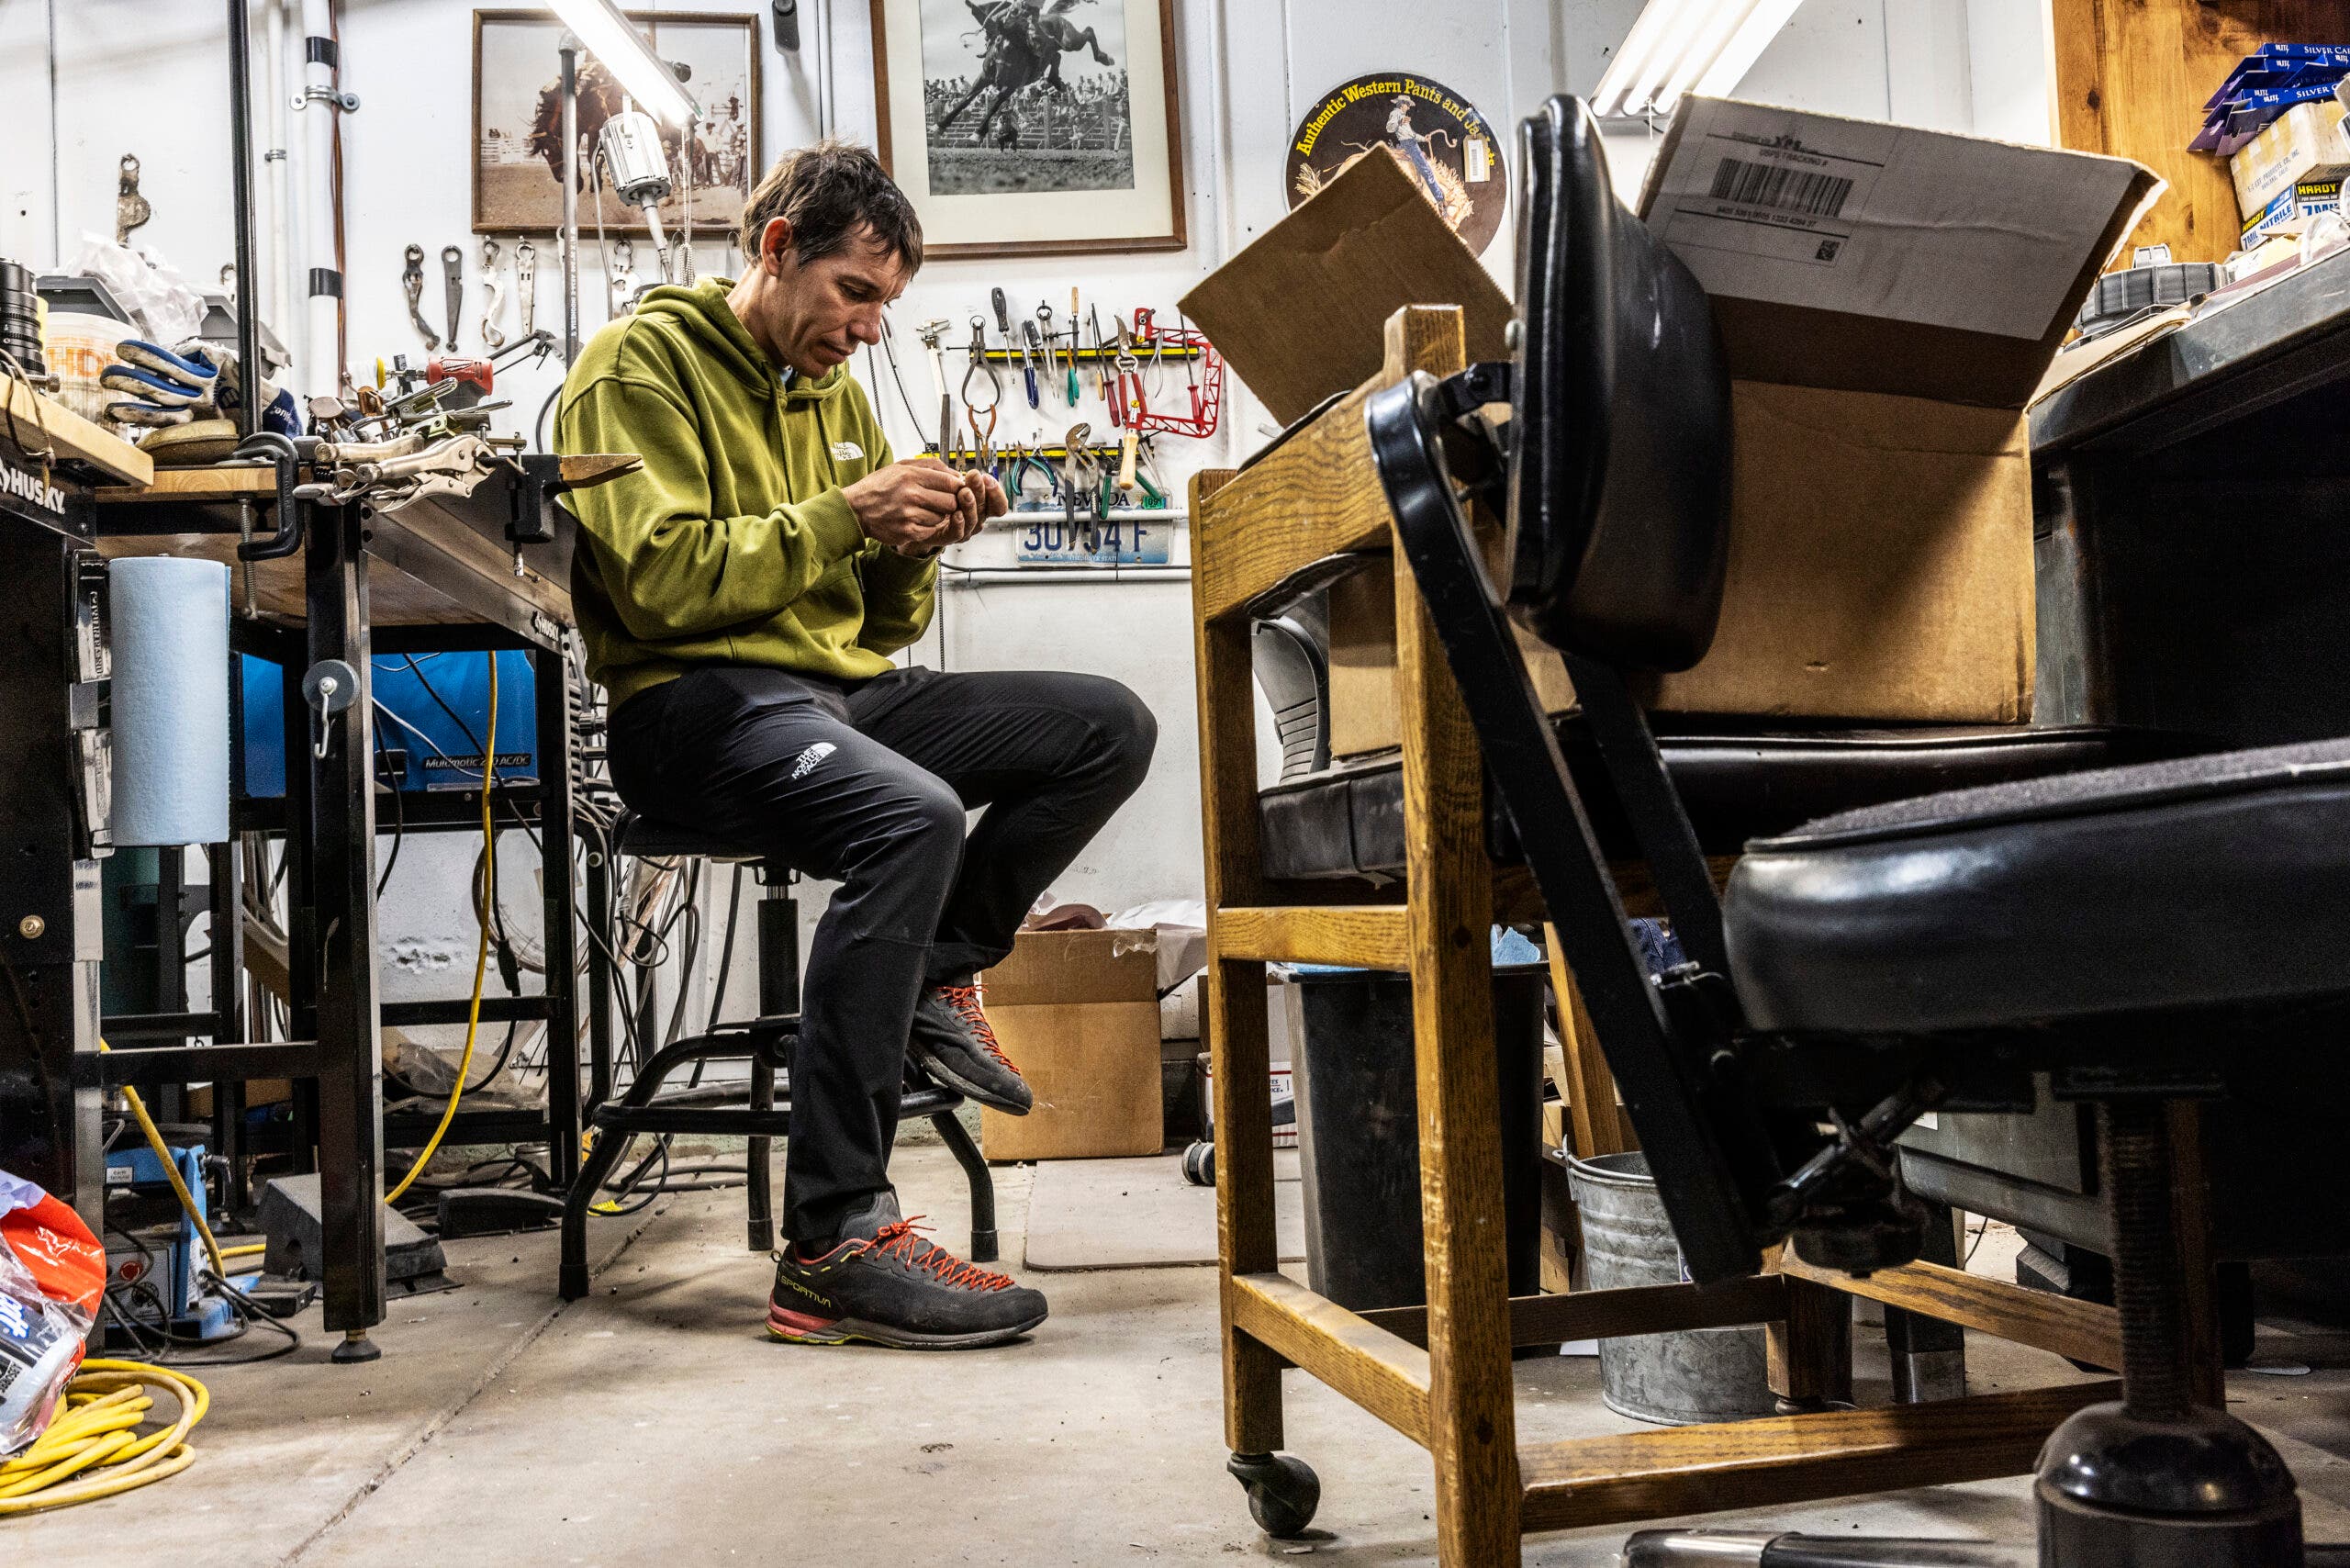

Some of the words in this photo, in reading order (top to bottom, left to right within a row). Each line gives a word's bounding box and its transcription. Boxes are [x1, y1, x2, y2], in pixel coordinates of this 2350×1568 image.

[2304, 46, 2333, 54] SILVER
[2296, 86, 2330, 98] SILVER
[1295, 95, 1347, 157] Authentic
[1342, 81, 1402, 104] Western
[1404, 78, 1443, 105] Pants
[1442, 97, 1471, 122] and
[1464, 118, 1495, 166] Jats
[2297, 183, 2336, 196] HARDY
[2242, 209, 2265, 233] HARDY
[2259, 204, 2292, 230] NITRILE
[10, 467, 65, 514] HUSKY
[1057, 491, 1130, 506] NEVDA
[1024, 521, 1122, 552] 3054
[498, 756, 530, 766] AC/DC
[780, 1275, 832, 1308] SPORTIVA
